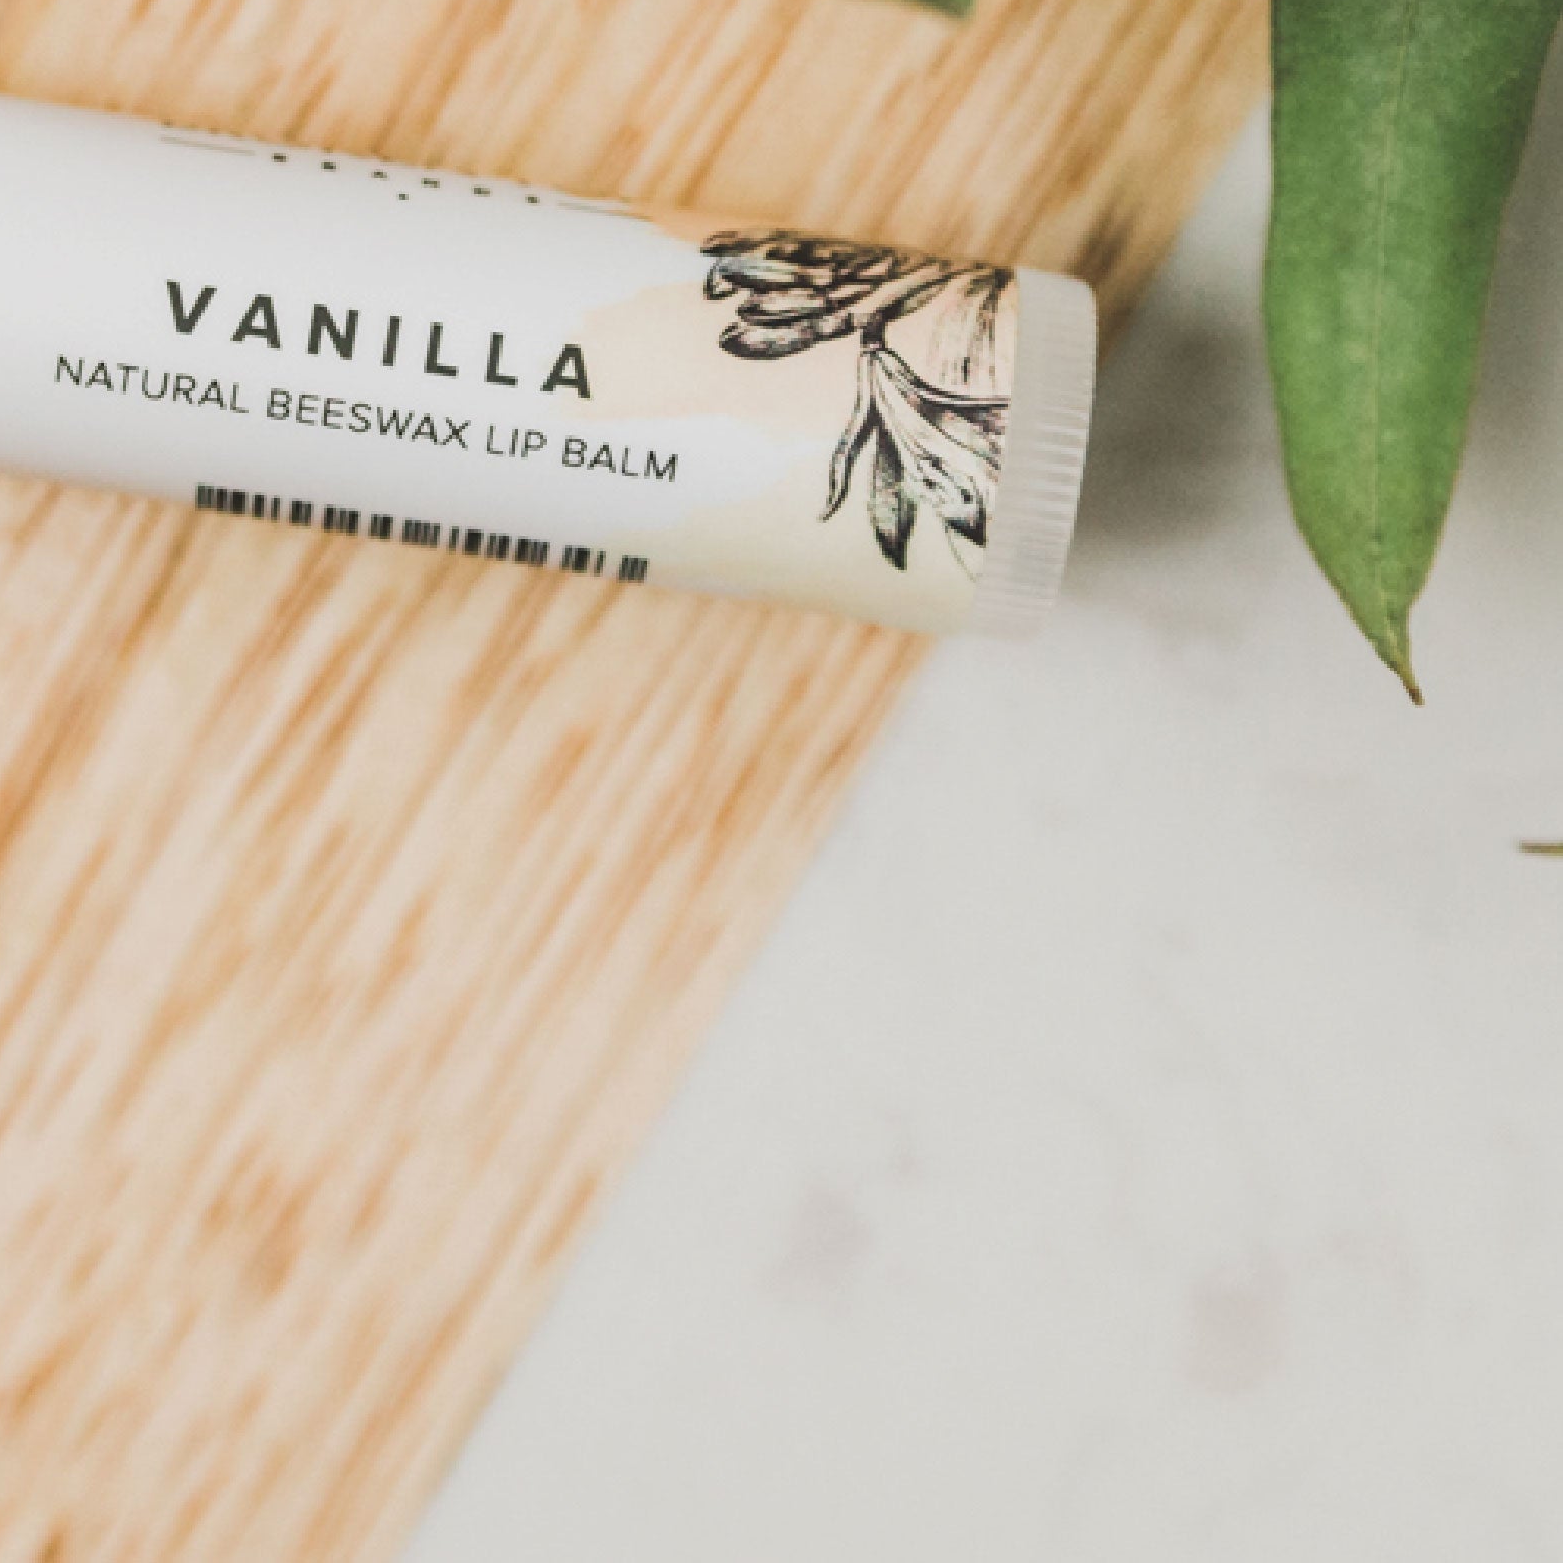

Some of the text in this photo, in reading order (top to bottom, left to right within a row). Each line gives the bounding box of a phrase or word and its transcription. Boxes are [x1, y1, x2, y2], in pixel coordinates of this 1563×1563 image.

[166, 279, 592, 399] VANILLA
[54, 354, 679, 483] NATURAL BEESWAX LIP BALM
